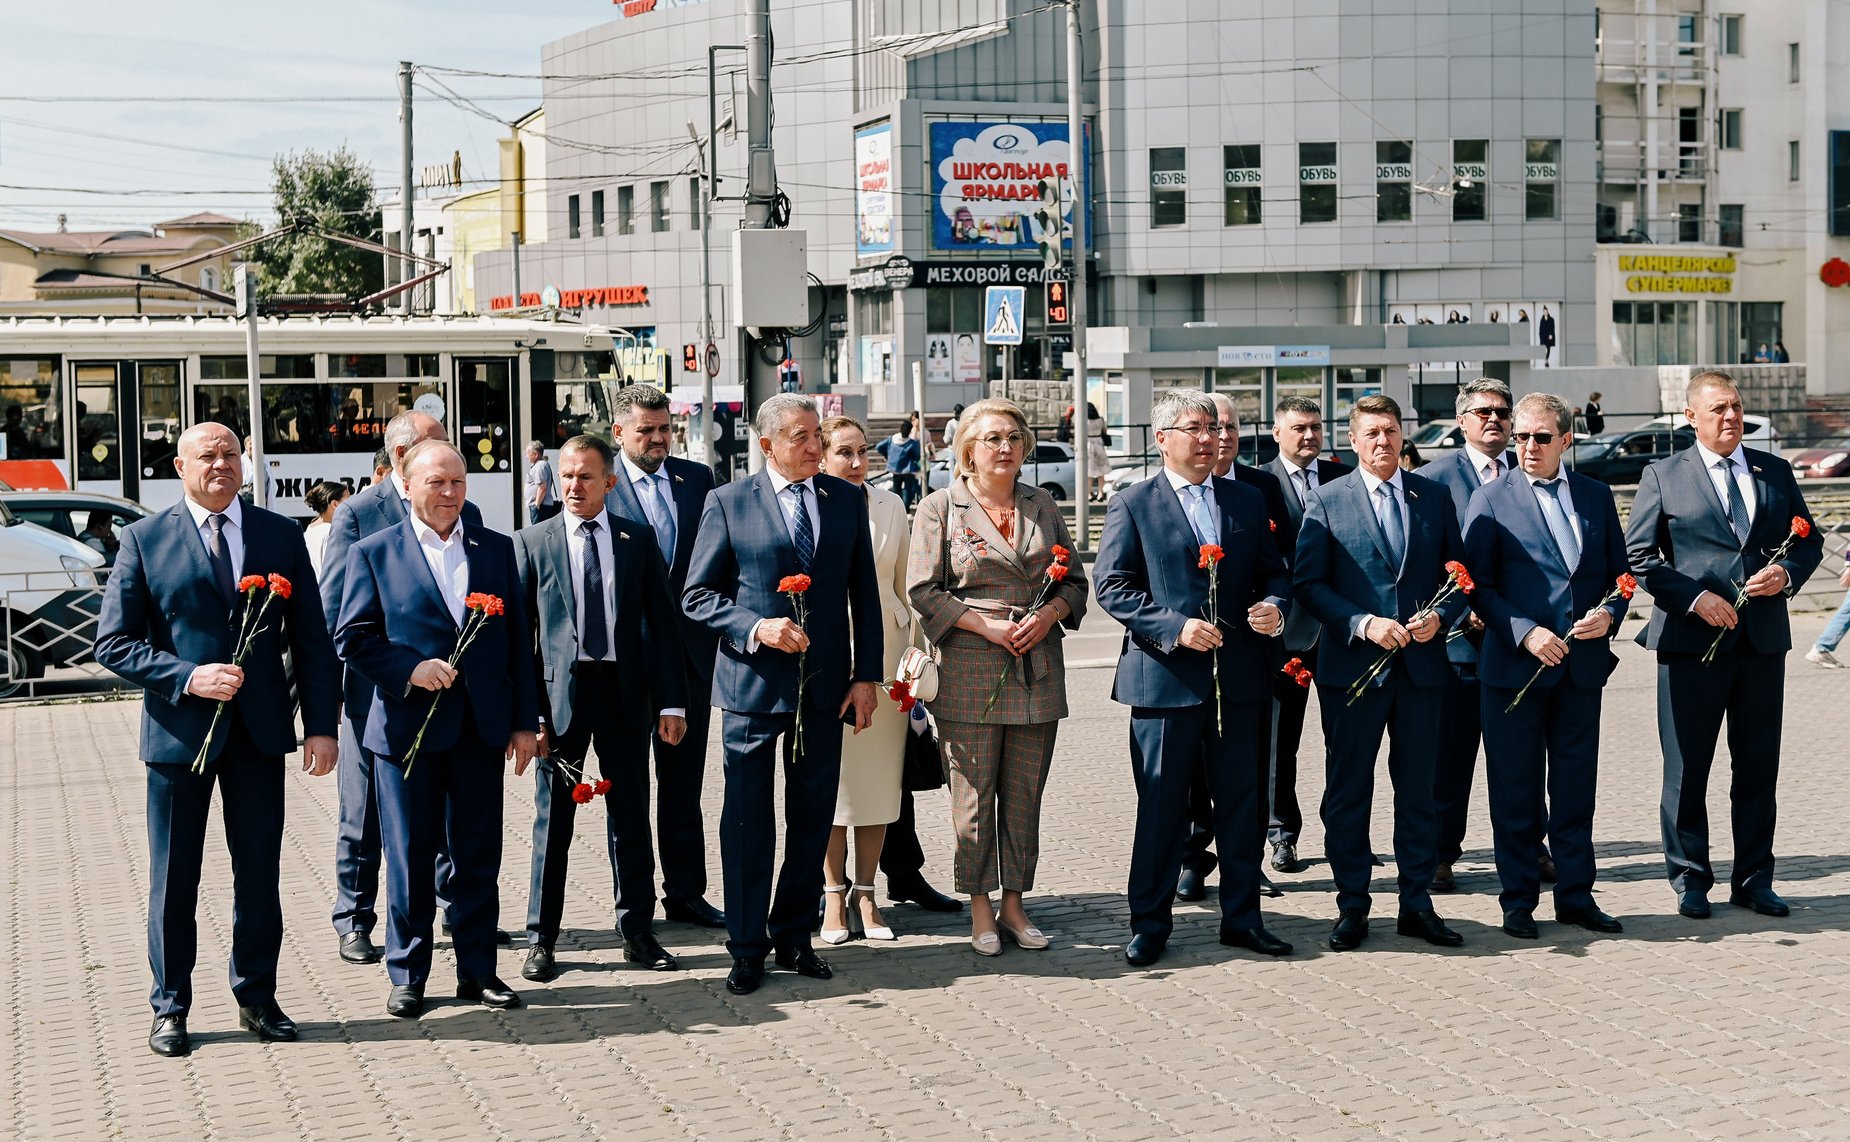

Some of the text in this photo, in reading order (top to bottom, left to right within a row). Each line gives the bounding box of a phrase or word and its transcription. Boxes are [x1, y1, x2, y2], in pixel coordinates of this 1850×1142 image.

[953, 162, 1068, 181] ШКОЛЬНАЯ
[1226, 170, 1262, 183] ОБУВЬ
[1301, 168, 1337, 181] ОБУВЬ
[1376, 166, 1411, 178] ОБУВЬ
[1153, 173, 1186, 185] ОБУВЬ
[961, 184, 1041, 202] ЯРМАРК
[884, 267, 914, 278] ВЕНЕРА
[927, 264, 1011, 284] МЕХОВОЙ
[560, 284, 648, 308] ИГРУШЕК
[1050, 306, 1066, 321] 40
[685, 359, 696, 370] 40
